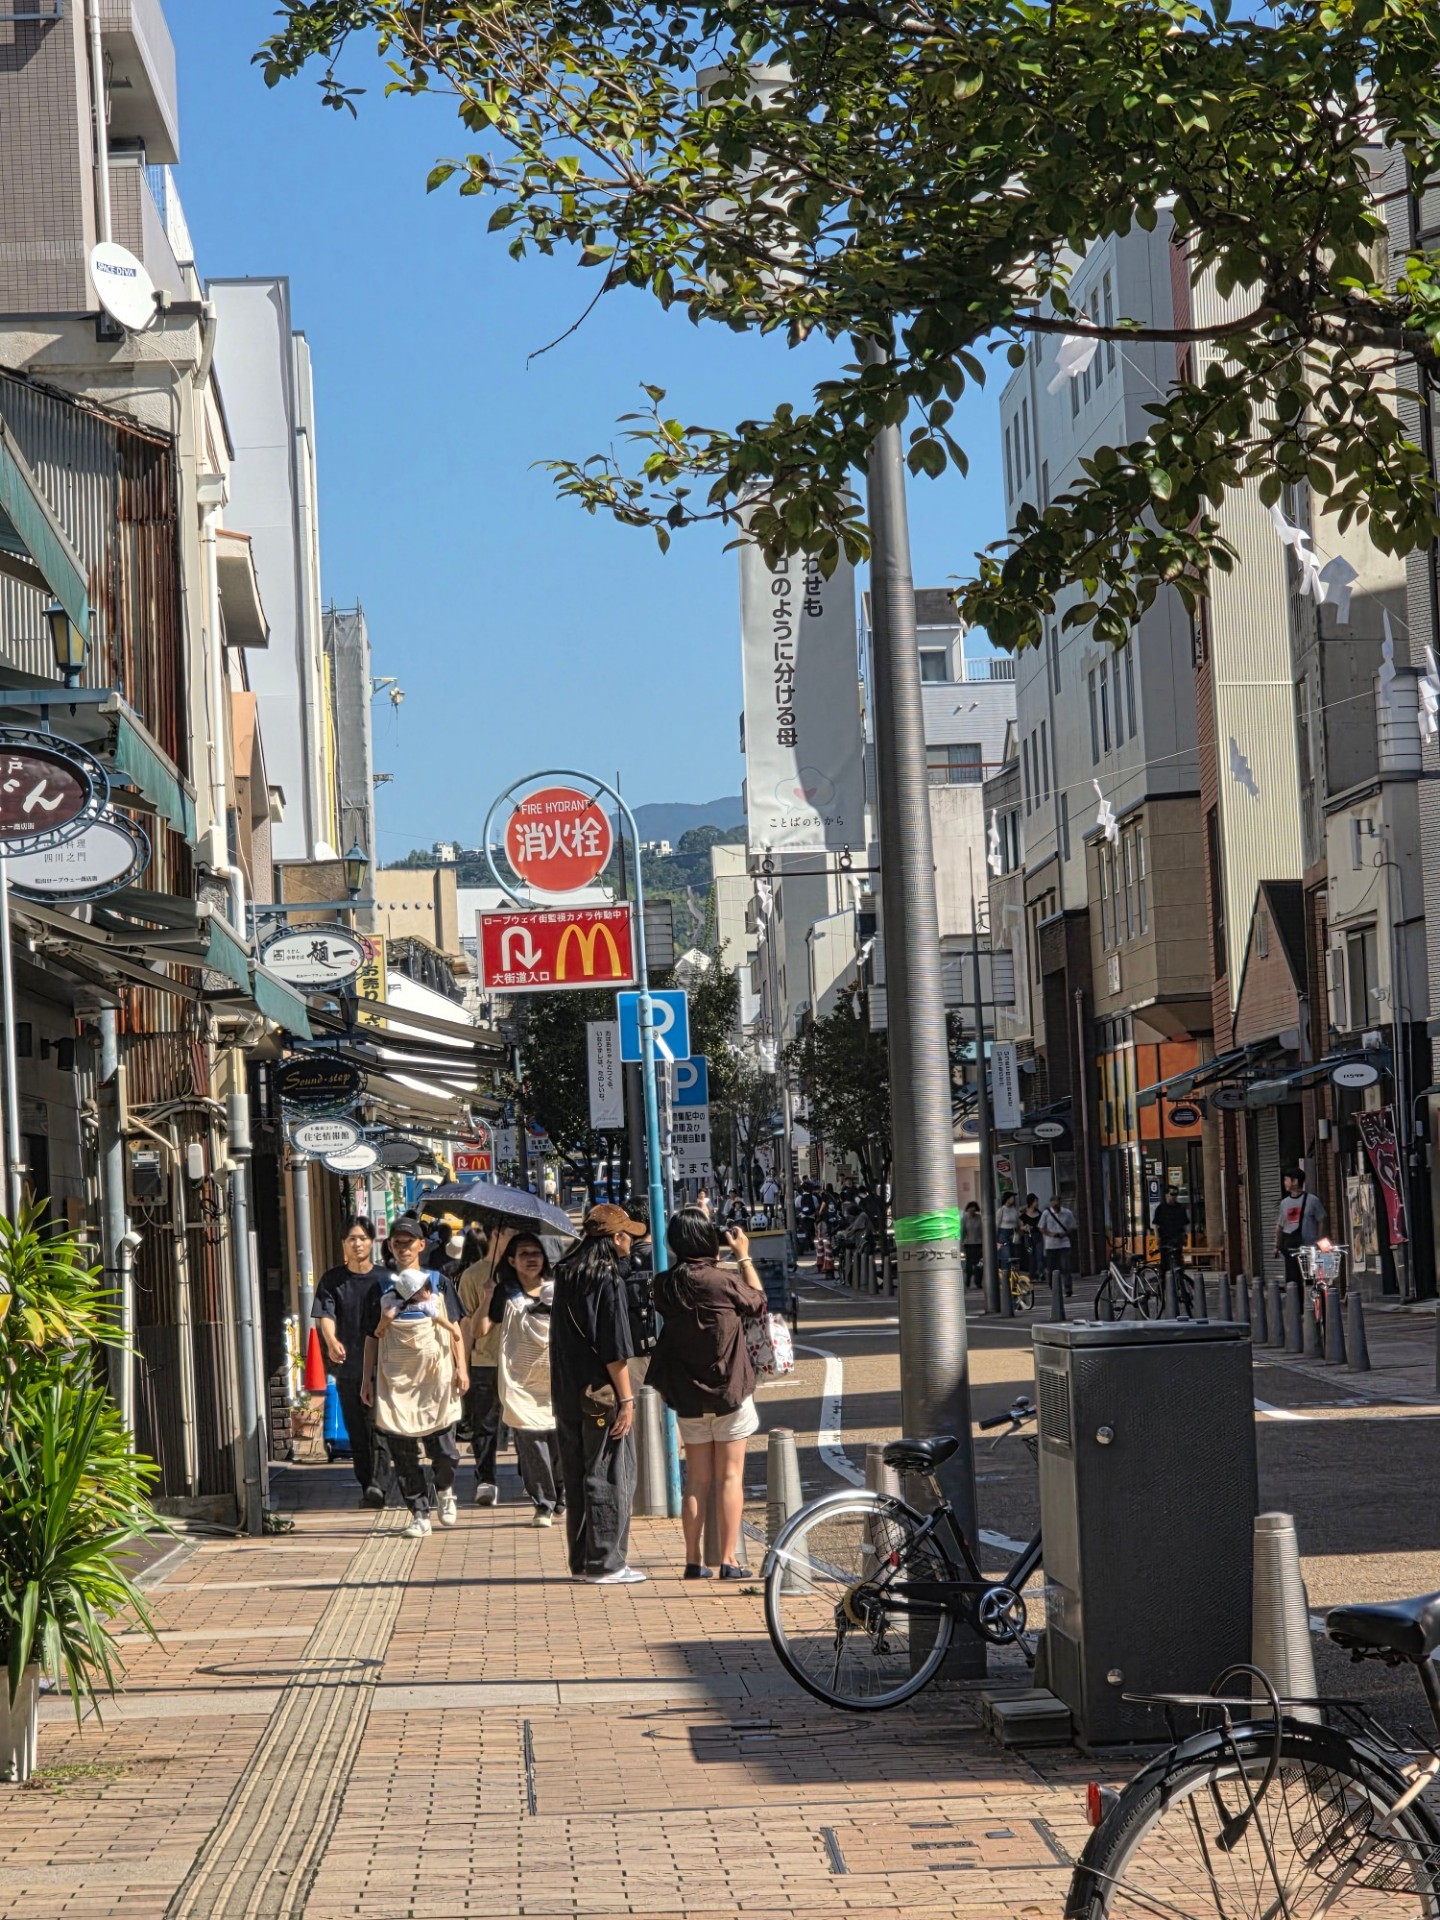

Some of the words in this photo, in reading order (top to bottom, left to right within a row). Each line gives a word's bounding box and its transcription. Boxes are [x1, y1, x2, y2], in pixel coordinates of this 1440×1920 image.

[520, 802, 543, 816] FIRE
[545, 799, 589, 815] HYDRANT
[769, 814, 845, 828] ことばのちから
[514, 816, 603, 863] 消火栓
[492, 971, 550, 985] 大街道入口
[304, 1131, 350, 1142] 住宅情報館
